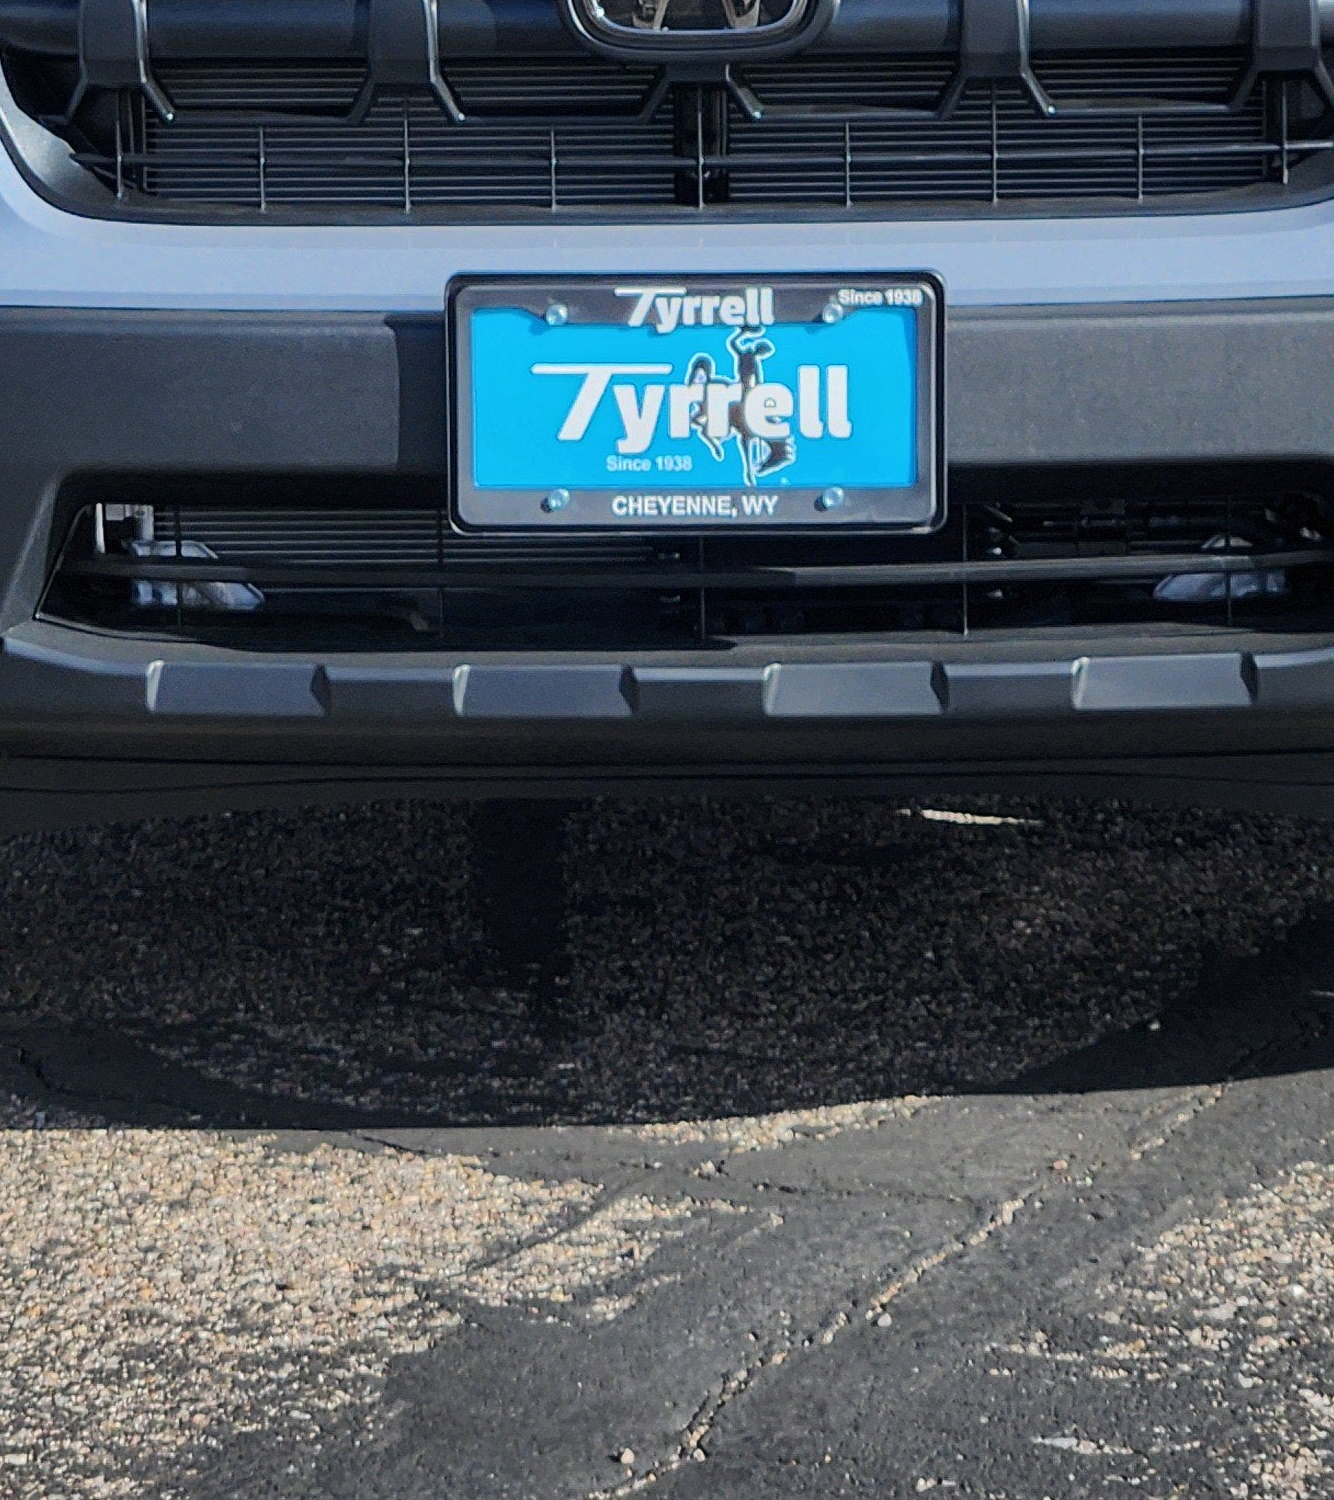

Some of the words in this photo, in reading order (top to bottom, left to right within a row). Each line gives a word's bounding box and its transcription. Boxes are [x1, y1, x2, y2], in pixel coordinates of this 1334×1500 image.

[614, 285, 776, 334] Tyrrell
[837, 288, 883, 306] Since
[885, 288, 924, 307] 1938
[530, 361, 854, 454] Tyrrell
[606, 455, 652, 472] Since
[655, 455, 693, 472] 1938
[611, 494, 738, 518] CHEYENNE,
[741, 494, 779, 516] WY
